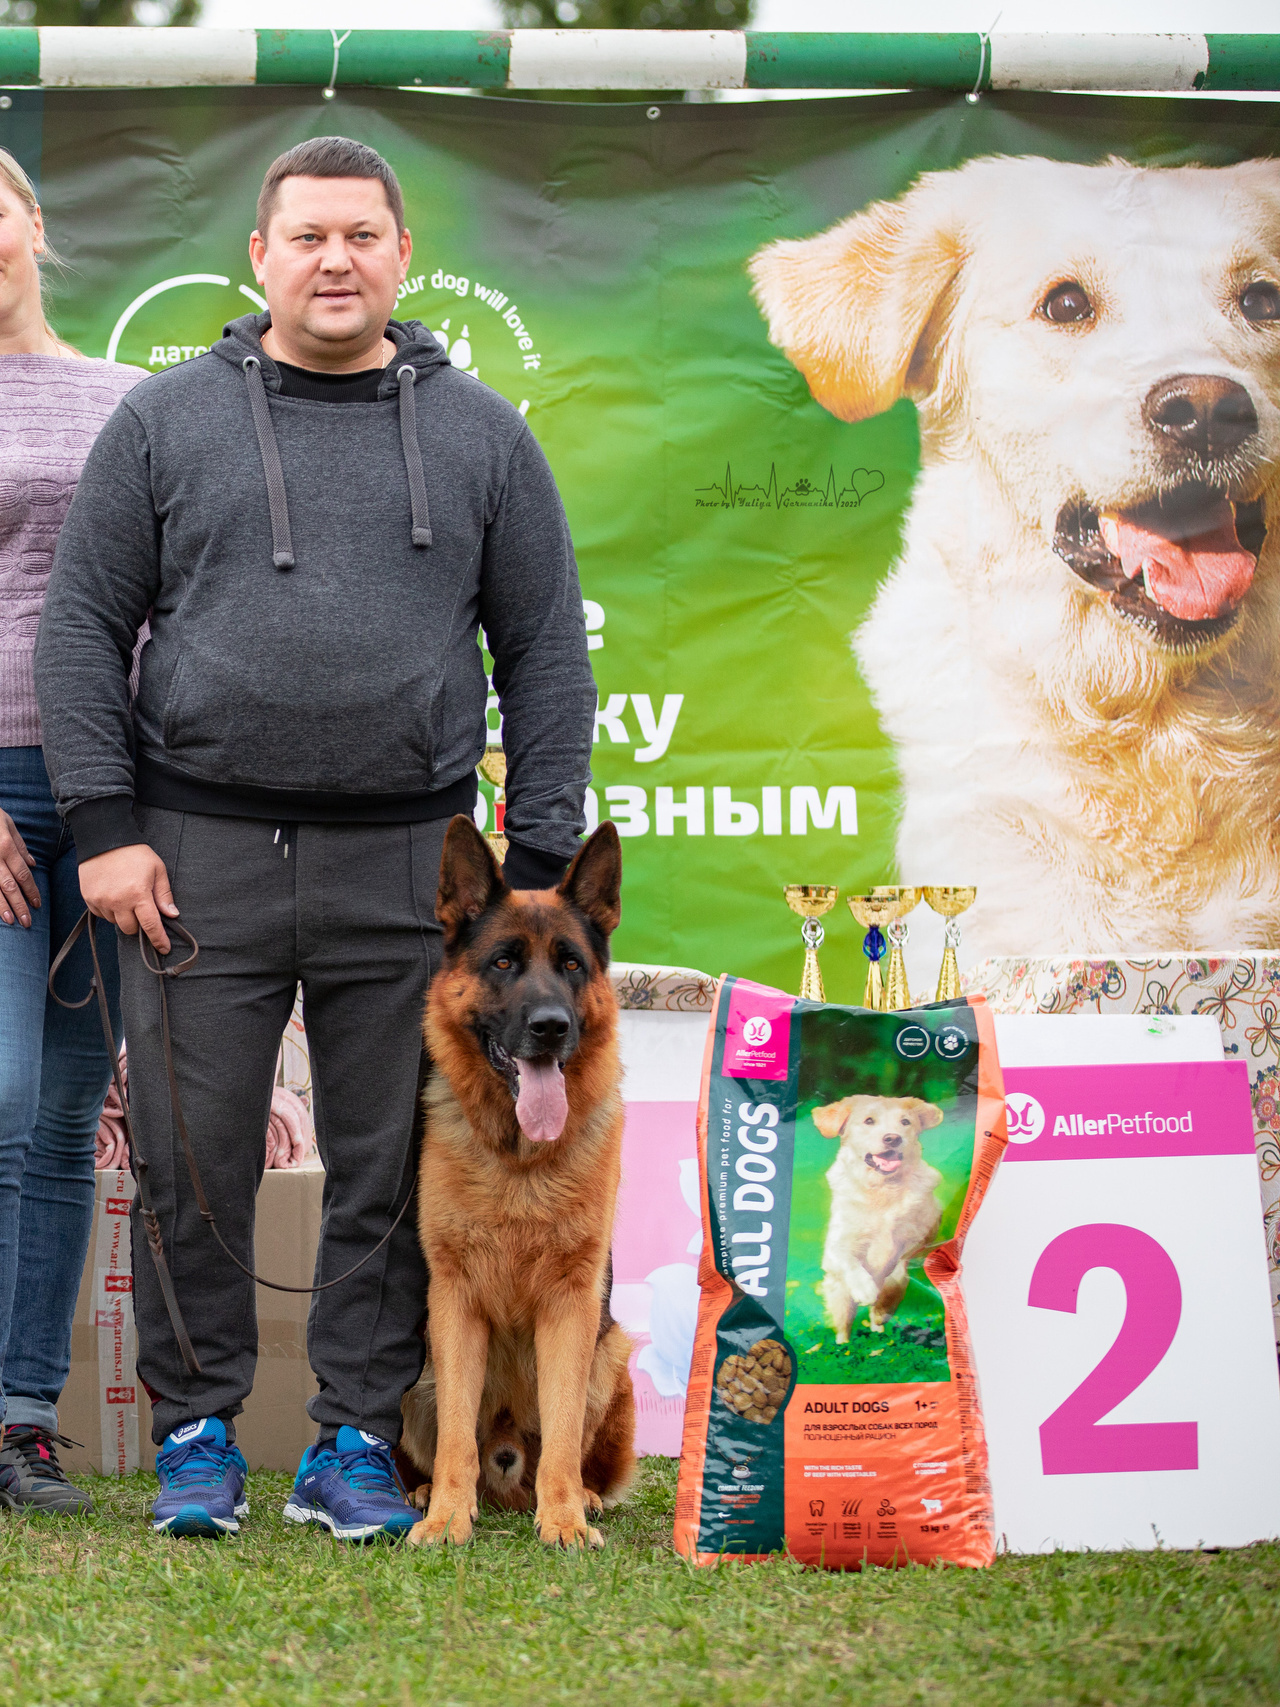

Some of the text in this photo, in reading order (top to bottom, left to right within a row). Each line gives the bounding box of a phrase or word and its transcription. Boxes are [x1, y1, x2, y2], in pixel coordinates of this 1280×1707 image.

[431, 268, 470, 297] dog
[474, 282, 509, 312] will
[502, 305, 533, 351] love
[522, 353, 542, 371] it
[735, 1049, 776, 1059] AllerPetfood
[1053, 1111, 1193, 1136] AllerPetfood
[718, 1098, 732, 1275] omplete premium pet food for
[731, 1102, 780, 1297] ALL DOGS
[114, 1298, 123, 1381] www.artans.ru
[1028, 1222, 1199, 1476] 2
[804, 1401, 890, 1413] ADULT DOGS
[915, 1400, 928, 1411] 1+
[803, 1424, 822, 1432] ДЛЯ
[894, 1422, 913, 1430] ВСЕХ
[914, 1421, 938, 1429] ПОРОД
[803, 1433, 896, 1441] ПОЛНОЦЕННЫЙ РАЦИОН
